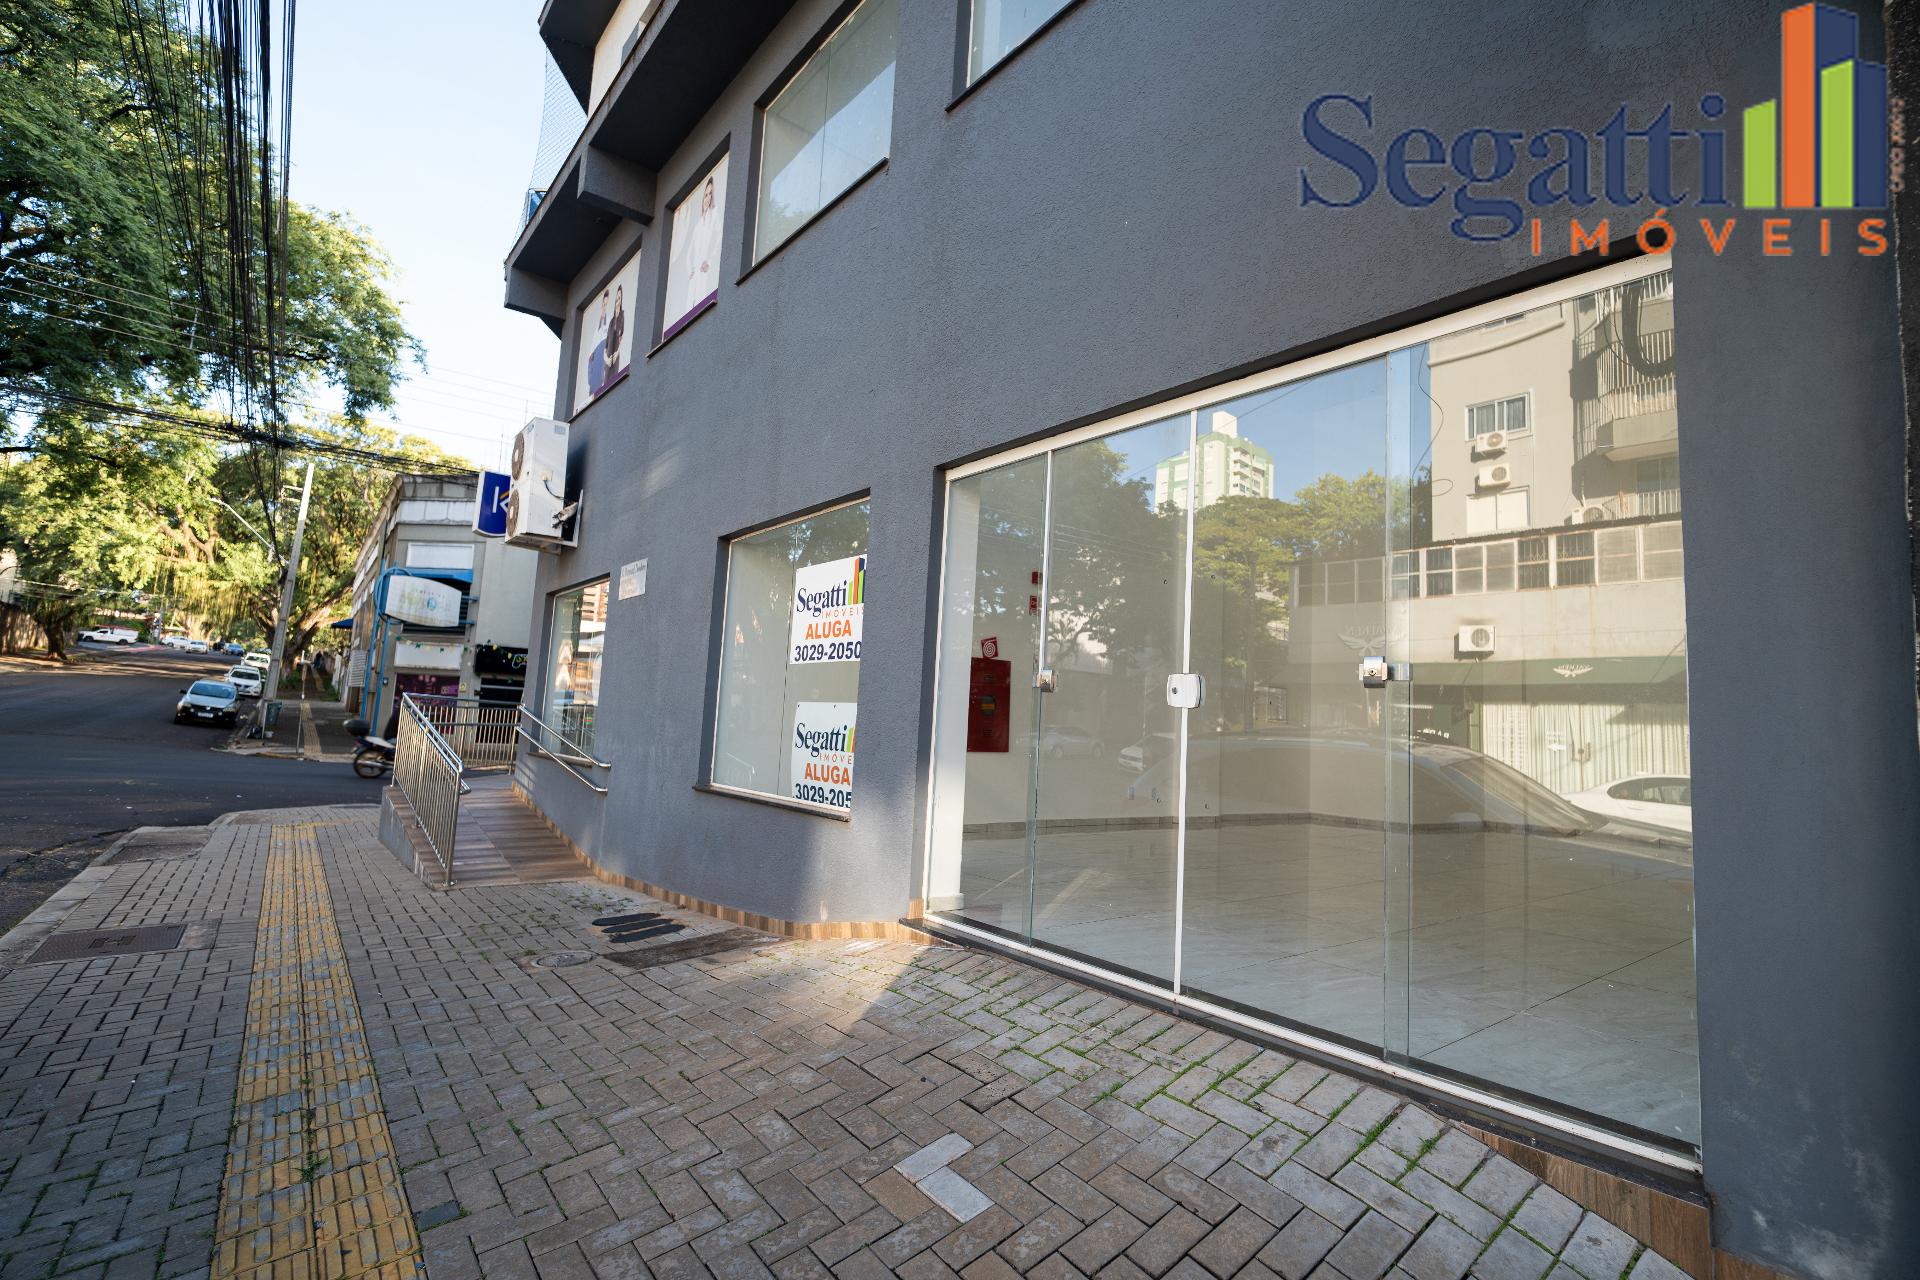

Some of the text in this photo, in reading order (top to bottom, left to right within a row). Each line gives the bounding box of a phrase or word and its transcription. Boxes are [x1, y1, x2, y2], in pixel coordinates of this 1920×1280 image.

[797, 580, 847, 617] Segatti
[805, 619, 852, 640] ALUGA
[794, 640, 862, 662] 3029-2050
[795, 722, 848, 757] Segatti
[804, 762, 851, 786] ALUGA
[795, 783, 852, 808] 3029-205
